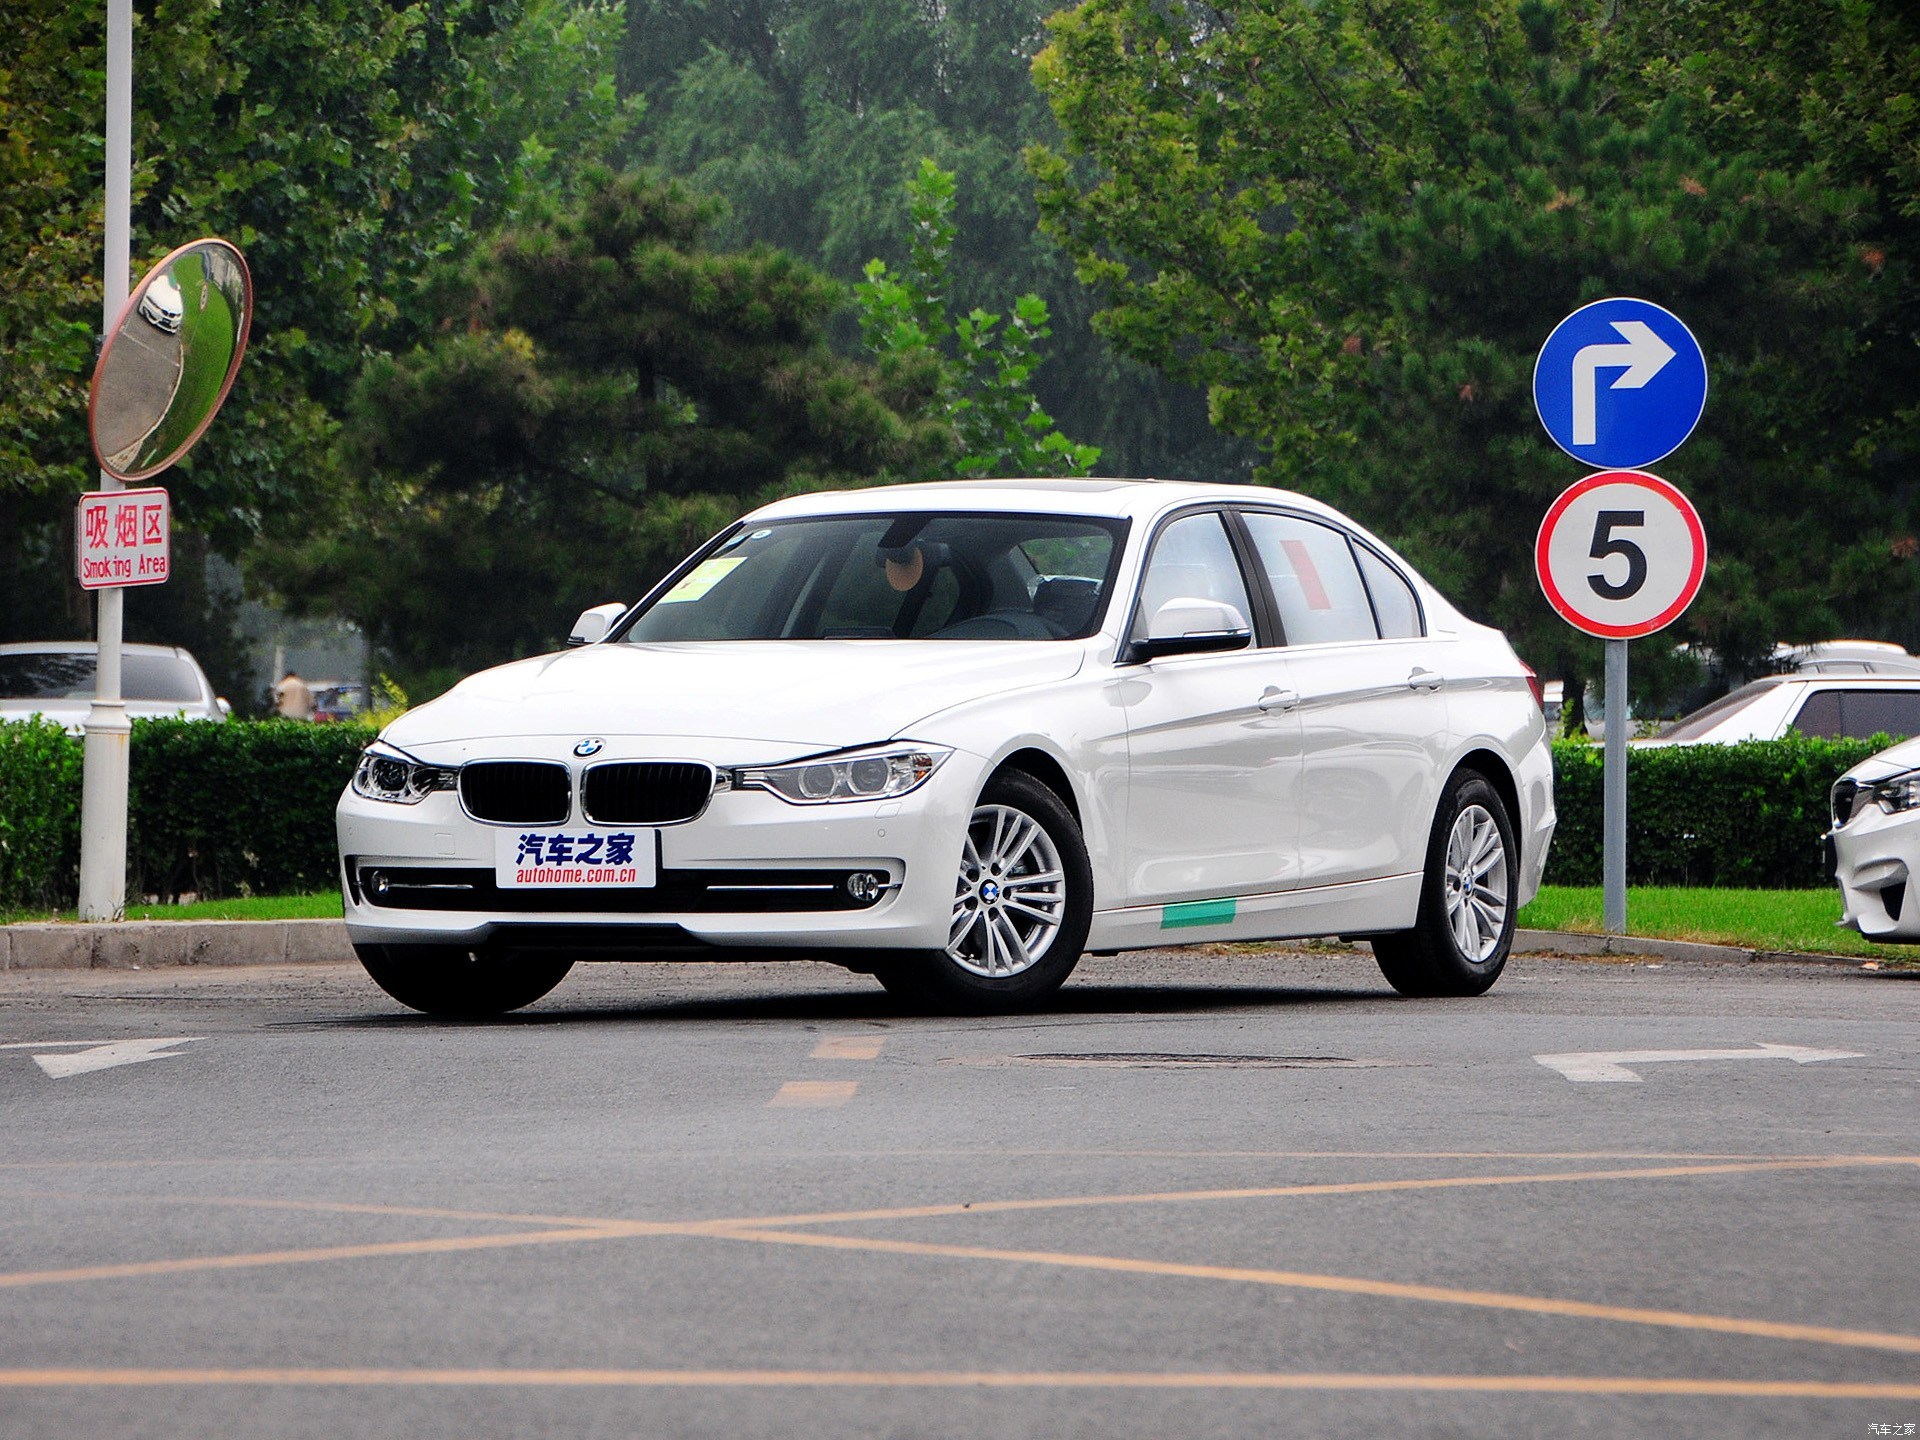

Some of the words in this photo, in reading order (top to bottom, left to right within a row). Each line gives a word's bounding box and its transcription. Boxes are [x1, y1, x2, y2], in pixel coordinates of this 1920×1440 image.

[86, 504, 162, 549] 吸烟区
[83, 556, 131, 578] Smoking
[138, 554, 166, 575] Area
[1587, 510, 1647, 601] 5
[516, 832, 636, 866] 汽车之家
[516, 867, 636, 883] autohome.com.cn
